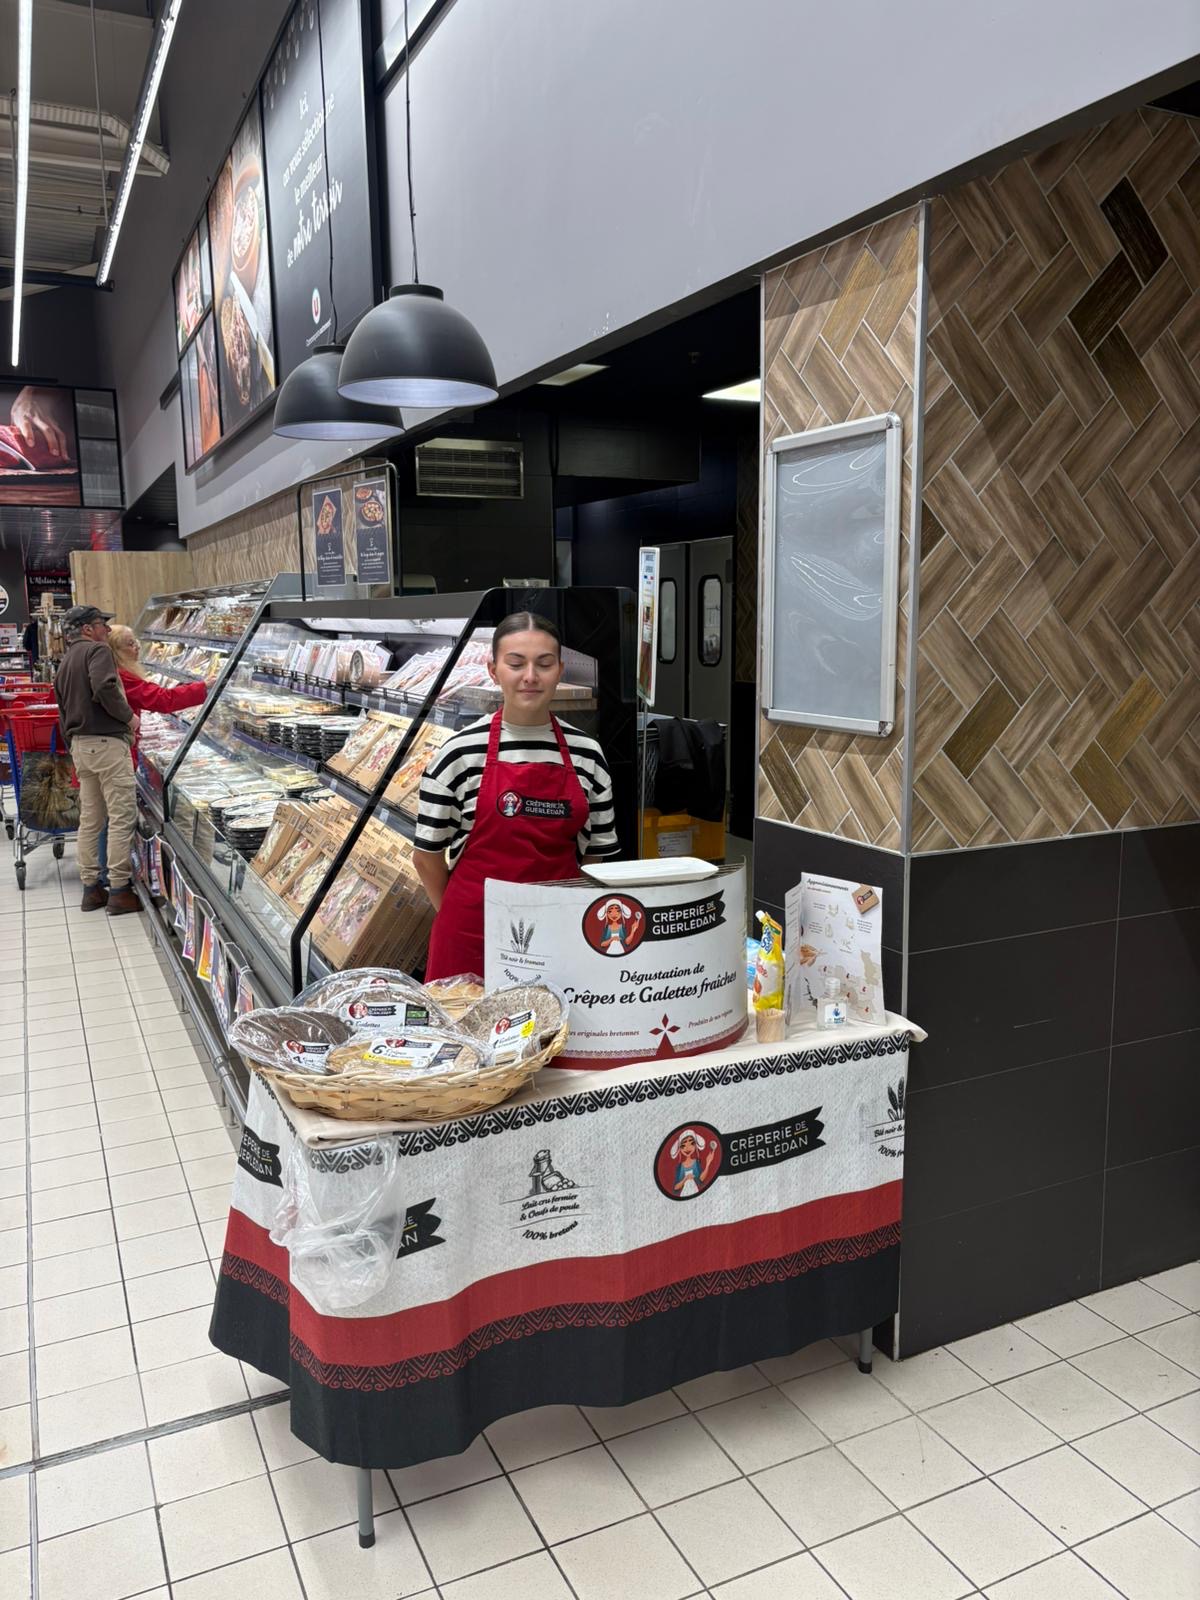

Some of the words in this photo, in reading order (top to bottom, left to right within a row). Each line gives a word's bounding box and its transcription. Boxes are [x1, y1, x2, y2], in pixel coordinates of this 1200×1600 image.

[620, 967, 691, 985] Dégustation
[693, 963, 705, 975] de
[563, 988, 616, 1008] Crêpes
[620, 993, 637, 1004] et
[639, 985, 698, 1003] Galettes
[699, 970, 737, 999] fraîches
[577, 1030, 608, 1038] originales
[609, 1029, 640, 1037] bretonnes
[795, 1120, 807, 1131] DE
[878, 1145, 897, 1157] 100%
[521, 1200, 537, 1211] Lait
[539, 1198, 551, 1206] cru
[551, 1193, 578, 1204] fermier
[520, 1213, 527, 1221] &
[549, 1205, 559, 1213] de
[559, 1203, 580, 1213] poule
[522, 1229, 548, 1240] 100%
[549, 1221, 578, 1239] bretons
